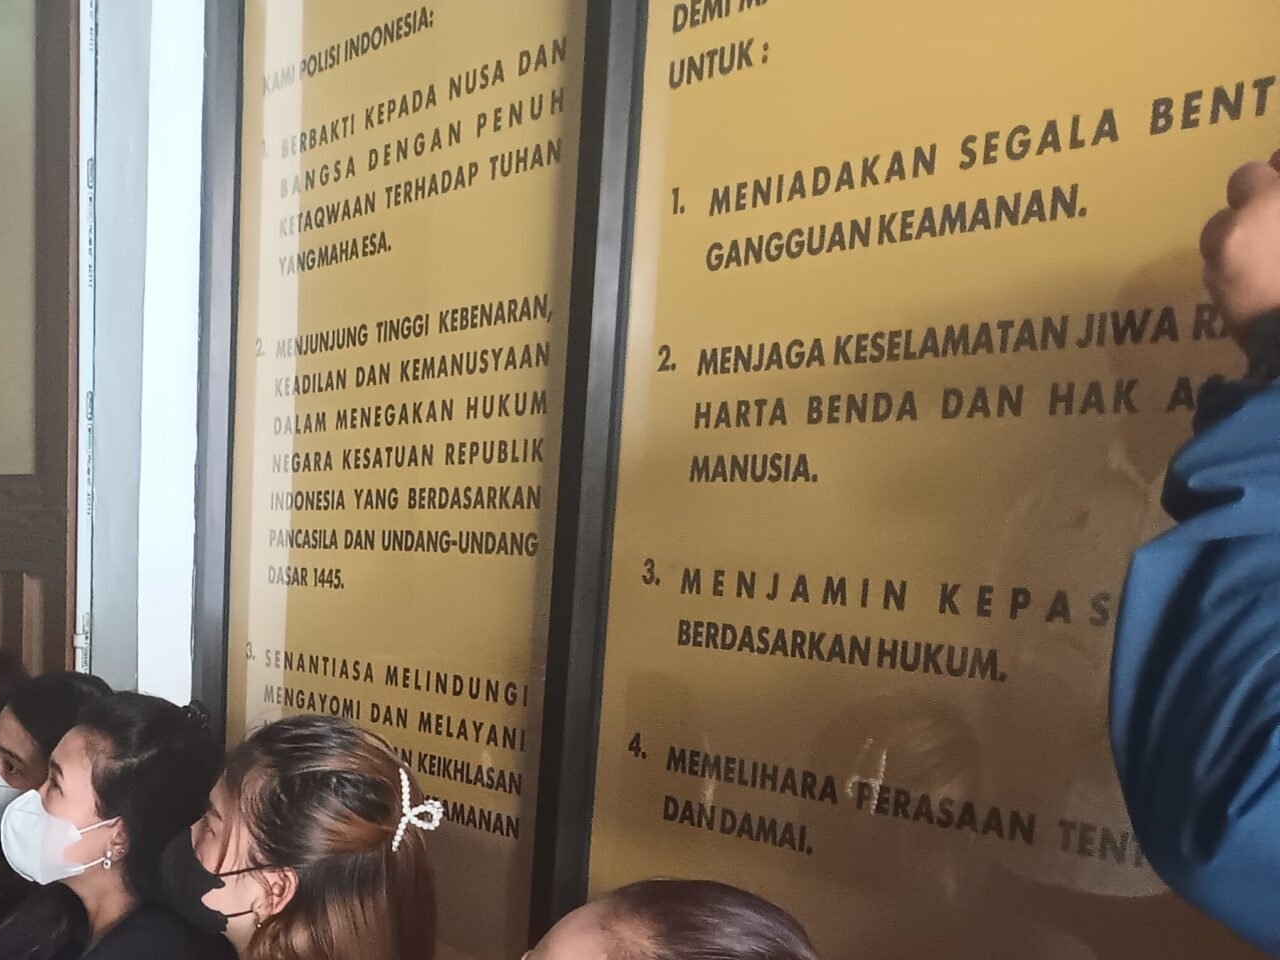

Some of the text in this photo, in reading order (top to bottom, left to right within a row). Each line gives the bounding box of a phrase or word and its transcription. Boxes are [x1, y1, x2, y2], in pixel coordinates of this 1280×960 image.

[300, 45, 340, 82] POLISI
[344, 7, 434, 62] INDONESIA:
[672, 0, 732, 34] DEMI
[669, 38, 754, 90] UNTUK
[281, 114, 355, 159] BERBAKTI
[365, 85, 436, 130] KEPADA
[449, 60, 505, 100] NUSA
[518, 36, 567, 76] DAN
[280, 87, 565, 198] BANGSA DENGAN PENUH
[671, 187, 685, 215] 1.
[959, 109, 1119, 172] SEGALA
[279, 138, 562, 238] KETAQWAAN TERHADAP TUHAN
[706, 183, 1088, 272] GANGGUAN KEAMANAN.
[275, 323, 368, 359] MENJUNJUNG
[376, 313, 429, 344] TINGGI
[438, 294, 553, 334] KEBENARAN,
[657, 345, 677, 372] 2.
[697, 338, 825, 376] MENJAGA
[834, 314, 1068, 367] KESELAMATAN
[1076, 306, 1179, 348] JIWA
[275, 342, 550, 398] KEADILAN DAN KEMANUSYAAN
[273, 390, 548, 435] DALAM MENEGAKAN HUKUM
[694, 398, 787, 430] HARTA
[807, 390, 918, 425] BENDA
[941, 384, 1024, 421] DAN
[1049, 379, 1138, 416] HAK
[272, 437, 544, 473] NEGARA KESATUAN REPUBLIK
[689, 453, 819, 483] MANUSIA.
[270, 485, 541, 511] INDONESIA YANG BERDASARKAN
[269, 528, 539, 557] PANCASILA DAN UNDANG-UNDANG
[268, 566, 345, 590] DASAR 1445.
[641, 558, 1113, 628] 3. MENJAMIN KEPAS
[265, 649, 374, 683] SENANTIASA
[385, 665, 529, 707] MELINDUNGI
[677, 619, 1008, 682] BERDASARKAN HUKUM.
[263, 685, 526, 752] MENGAYOMI DAN MELAYANI
[418, 752, 522, 796] KEIKHLASAN
[627, 733, 649, 760] 4.
[666, 746, 838, 805] MEMELIHARA
[856, 781, 1036, 846] PERASAAN
[425, 795, 521, 839] AMANAN
[663, 795, 814, 855] DAN DAMAI.
